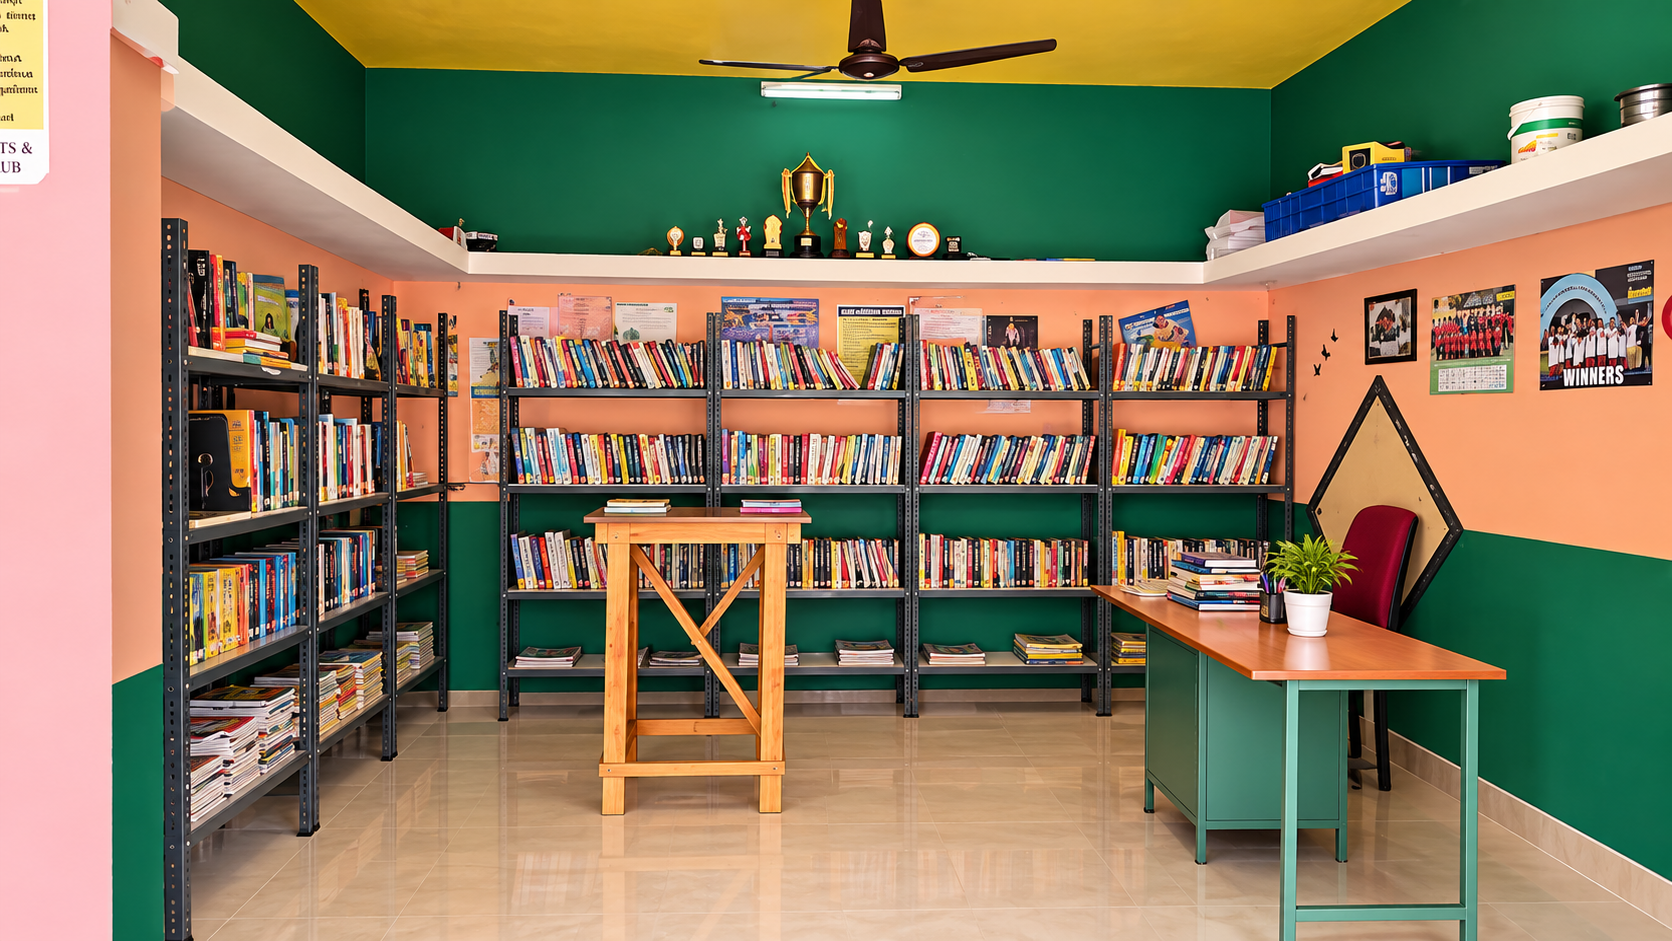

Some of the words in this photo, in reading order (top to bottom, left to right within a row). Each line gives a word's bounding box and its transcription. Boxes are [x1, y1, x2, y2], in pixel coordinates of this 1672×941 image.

[21, 141, 33, 154] &
[0, 161, 21, 174] UB
[1563, 365, 1625, 387] WINNERS
